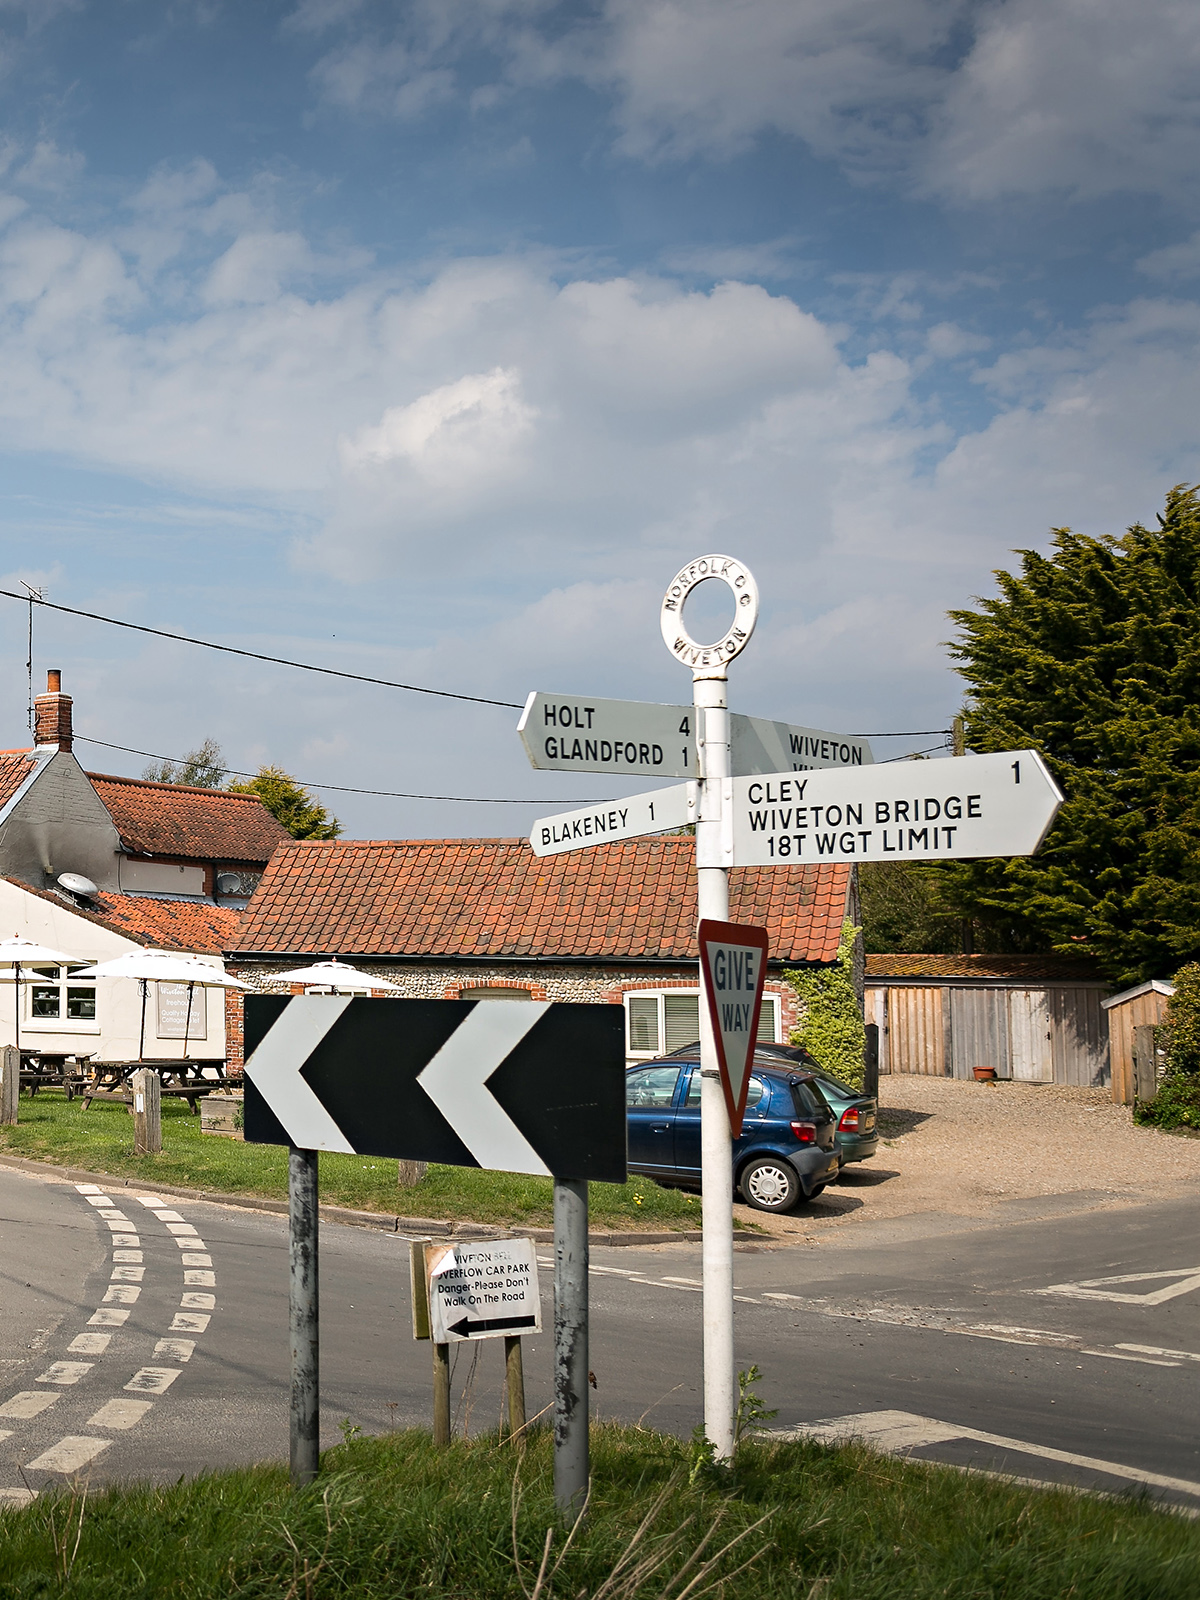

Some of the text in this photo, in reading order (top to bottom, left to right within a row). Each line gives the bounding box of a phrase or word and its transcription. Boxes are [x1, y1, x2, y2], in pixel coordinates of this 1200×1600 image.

[665, 559, 735, 611] NORFOLK
[673, 627, 747, 665] WIVETON
[544, 704, 690, 737] HOLT 4
[545, 737, 688, 767] GLANDFORD 1
[789, 733, 862, 766] WIVETON
[748, 760, 1021, 805] CLEY 1
[541, 802, 655, 846] BLAKENEY 1
[749, 795, 982, 832] WIVETON BRIDGE
[767, 826, 958, 857] 18T WGT LIMIT
[714, 949, 755, 991] GIVE
[722, 1003, 750, 1032] WAY
[485, 1265, 505, 1276] CAR
[507, 1263, 530, 1274] PARK
[506, 1277, 529, 1288] Don't
[444, 1291, 525, 1307] Walk On The Road
